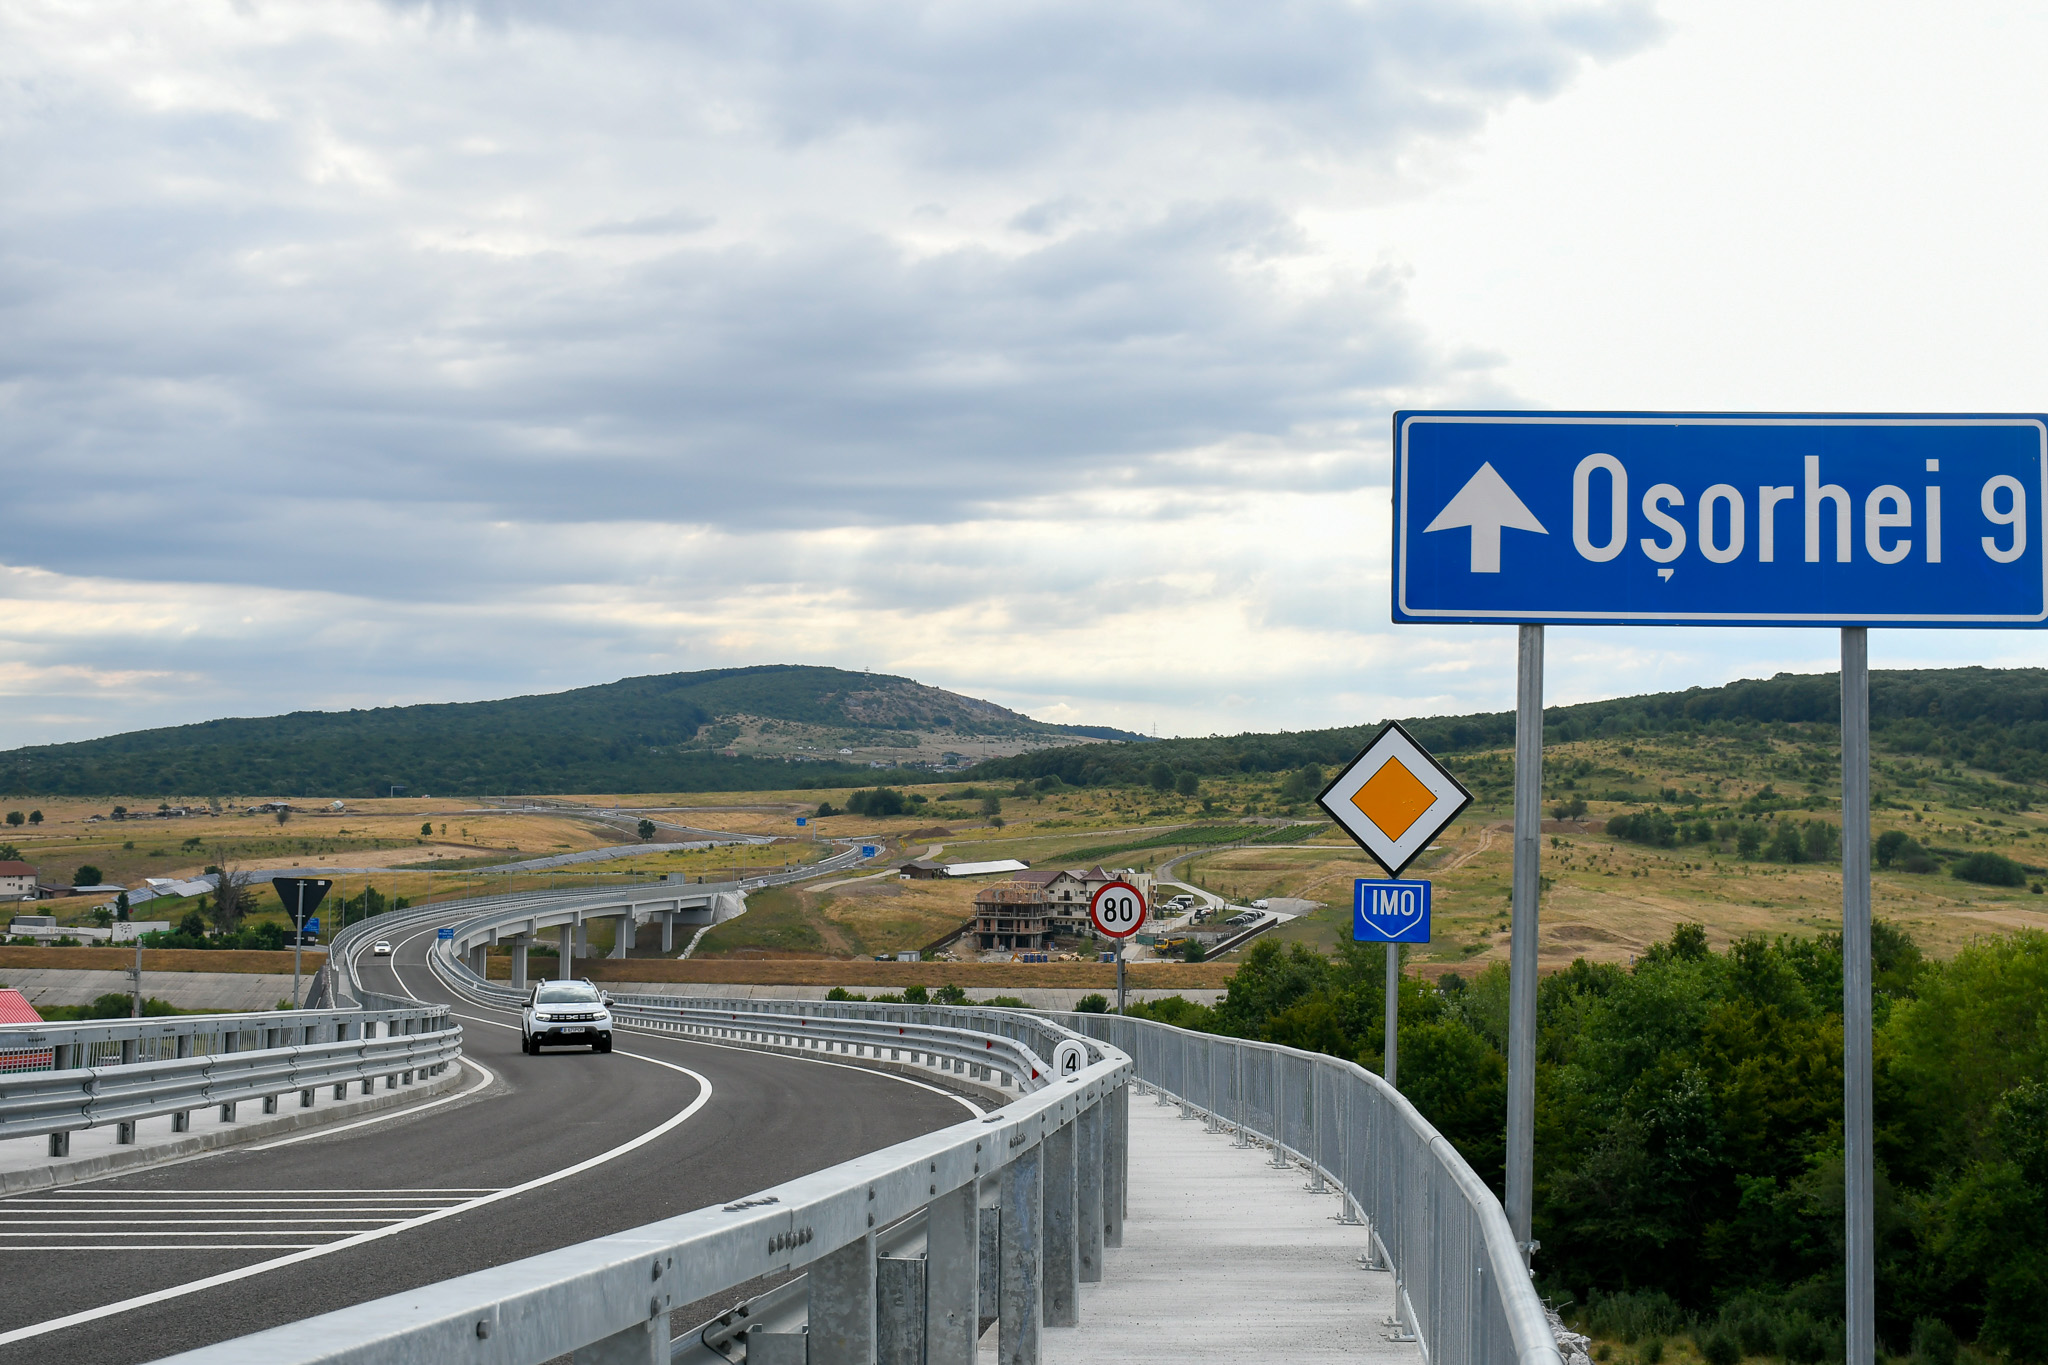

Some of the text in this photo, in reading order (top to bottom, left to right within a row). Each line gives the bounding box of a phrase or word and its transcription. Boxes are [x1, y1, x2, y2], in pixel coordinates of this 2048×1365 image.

[1572, 452, 2027, 583] Oșorhei 9
[1103, 896, 1133, 923] 80
[1372, 889, 1415, 916] IMO
[1065, 1052, 1077, 1072] 4
